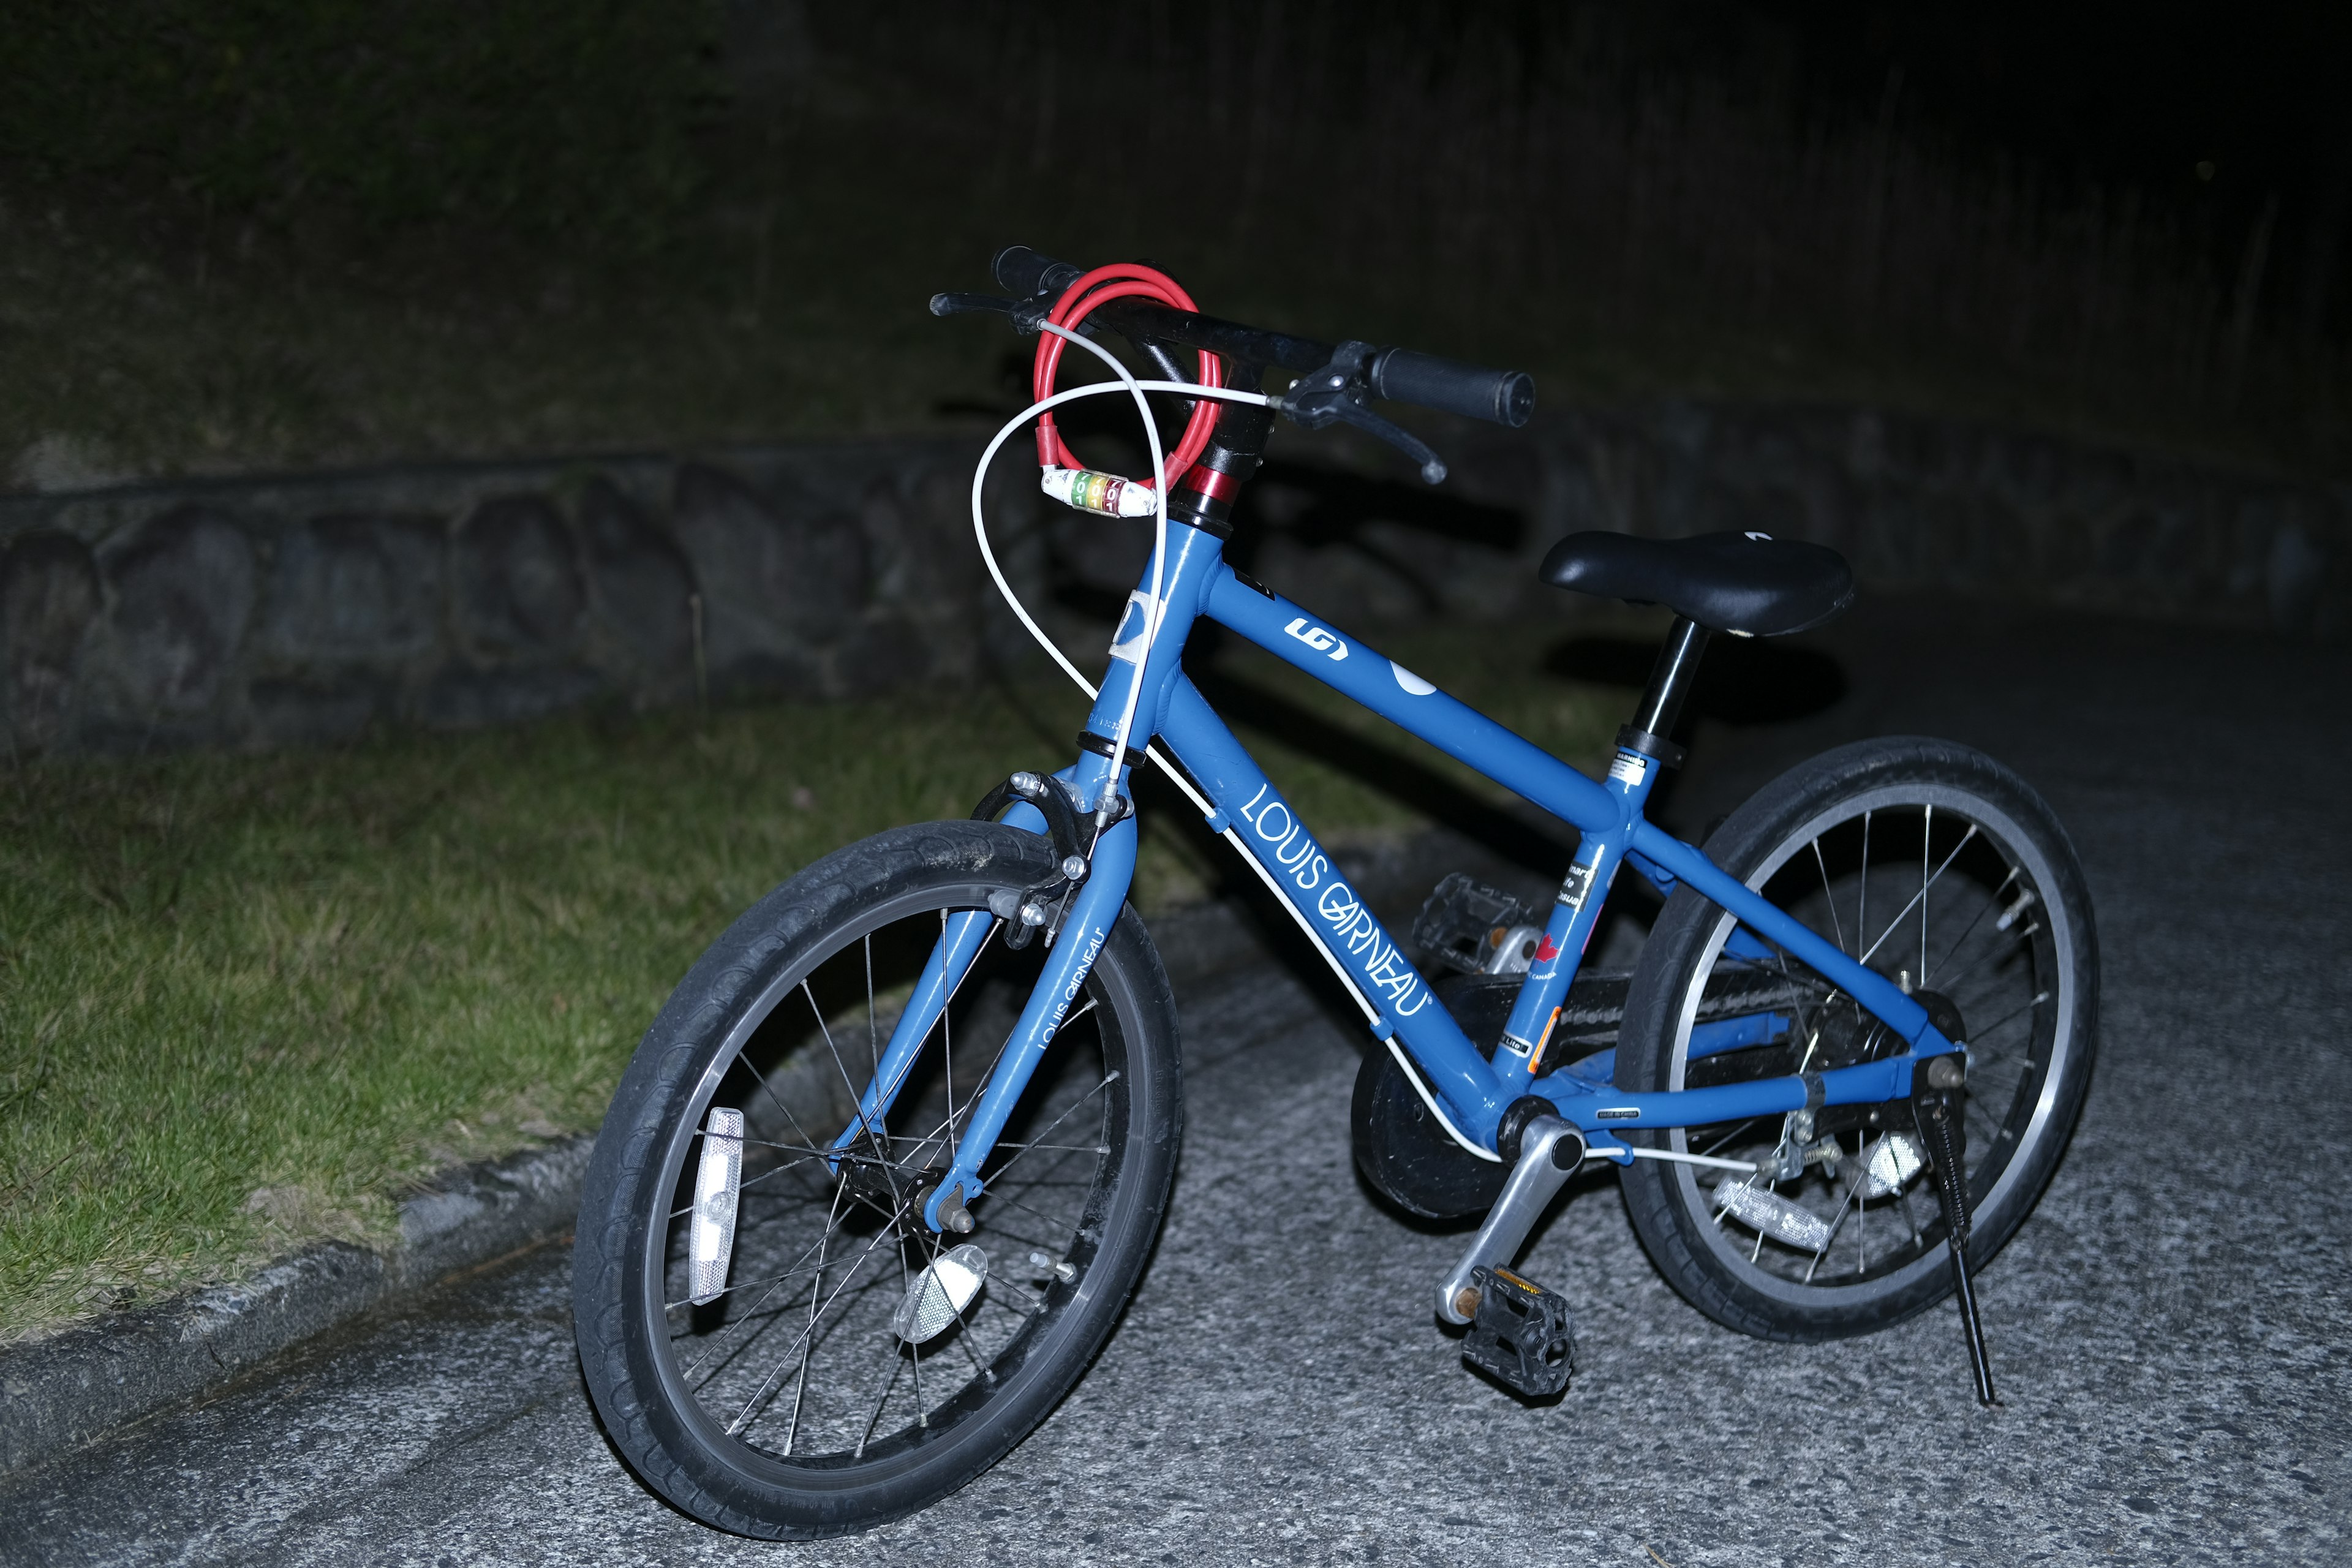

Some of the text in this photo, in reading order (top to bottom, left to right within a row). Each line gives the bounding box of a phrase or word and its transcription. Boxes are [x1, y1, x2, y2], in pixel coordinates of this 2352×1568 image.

[1240, 783, 1327, 889] LOUIS
[1038, 929, 1105, 1050] LOUIS GARNEAU
[1532, 971, 1557, 980] CANADA
